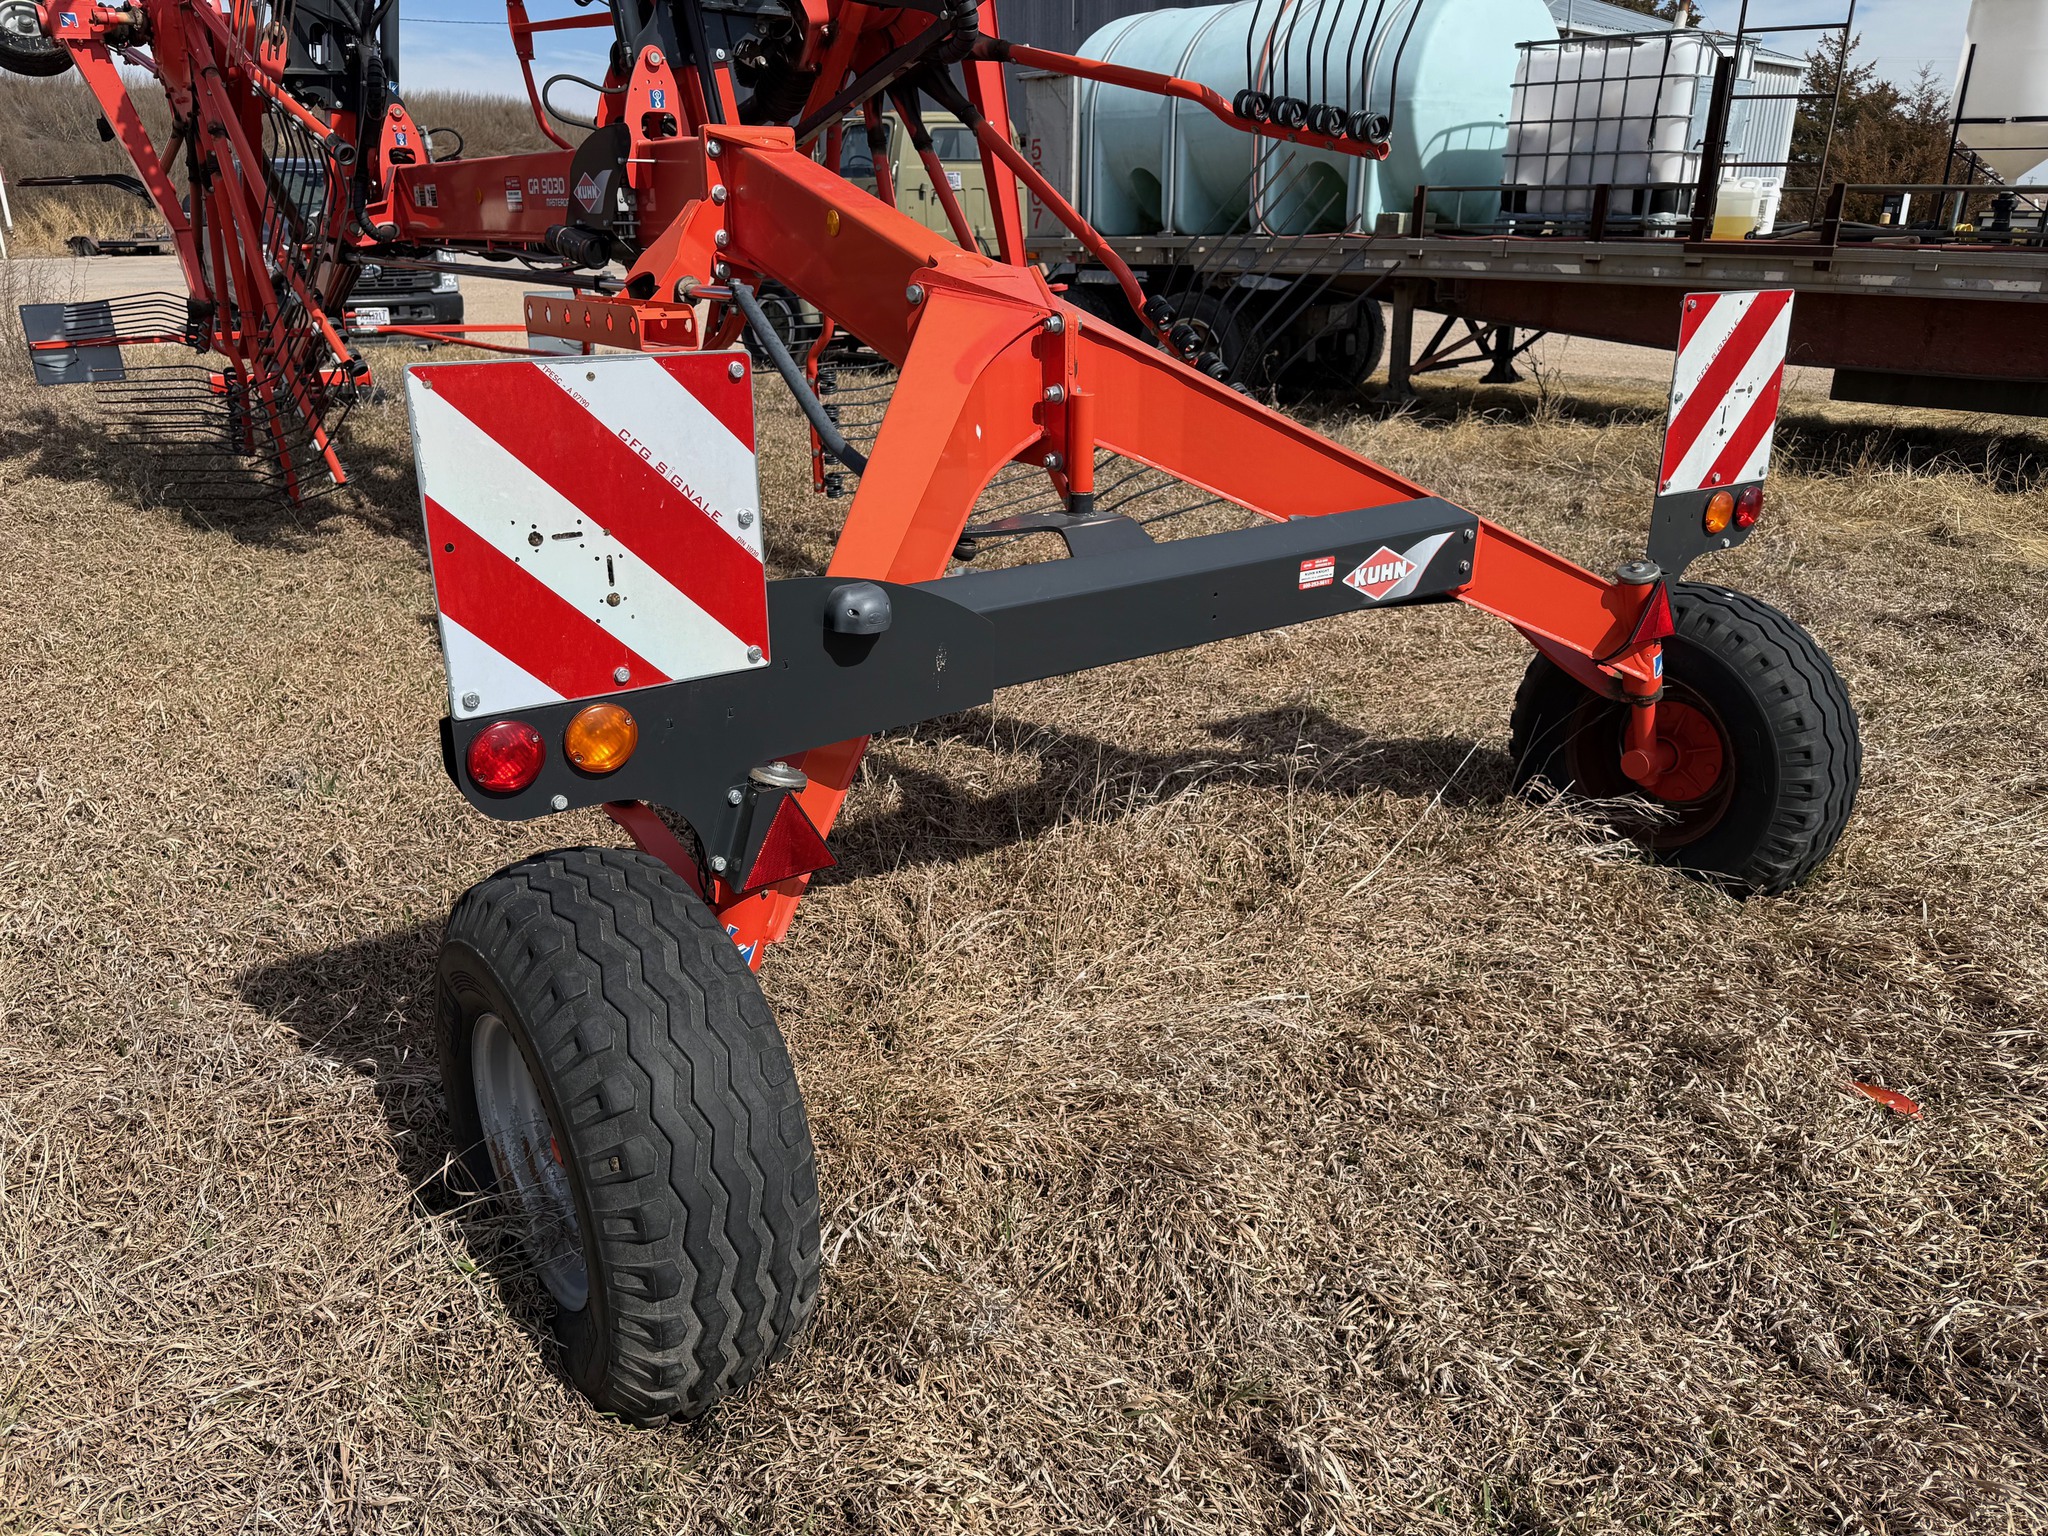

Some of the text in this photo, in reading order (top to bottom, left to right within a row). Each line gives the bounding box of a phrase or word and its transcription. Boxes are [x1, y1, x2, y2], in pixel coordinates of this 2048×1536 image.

[527, 178, 540, 195] GA
[541, 177, 565, 195] 9030
[577, 184, 598, 200] KUHN
[541, 364, 563, 385] TPESC
[572, 391, 590, 408] 07190
[617, 428, 652, 461] CFG
[736, 535, 747, 547] DIN
[1354, 560, 1408, 588] KUHN
